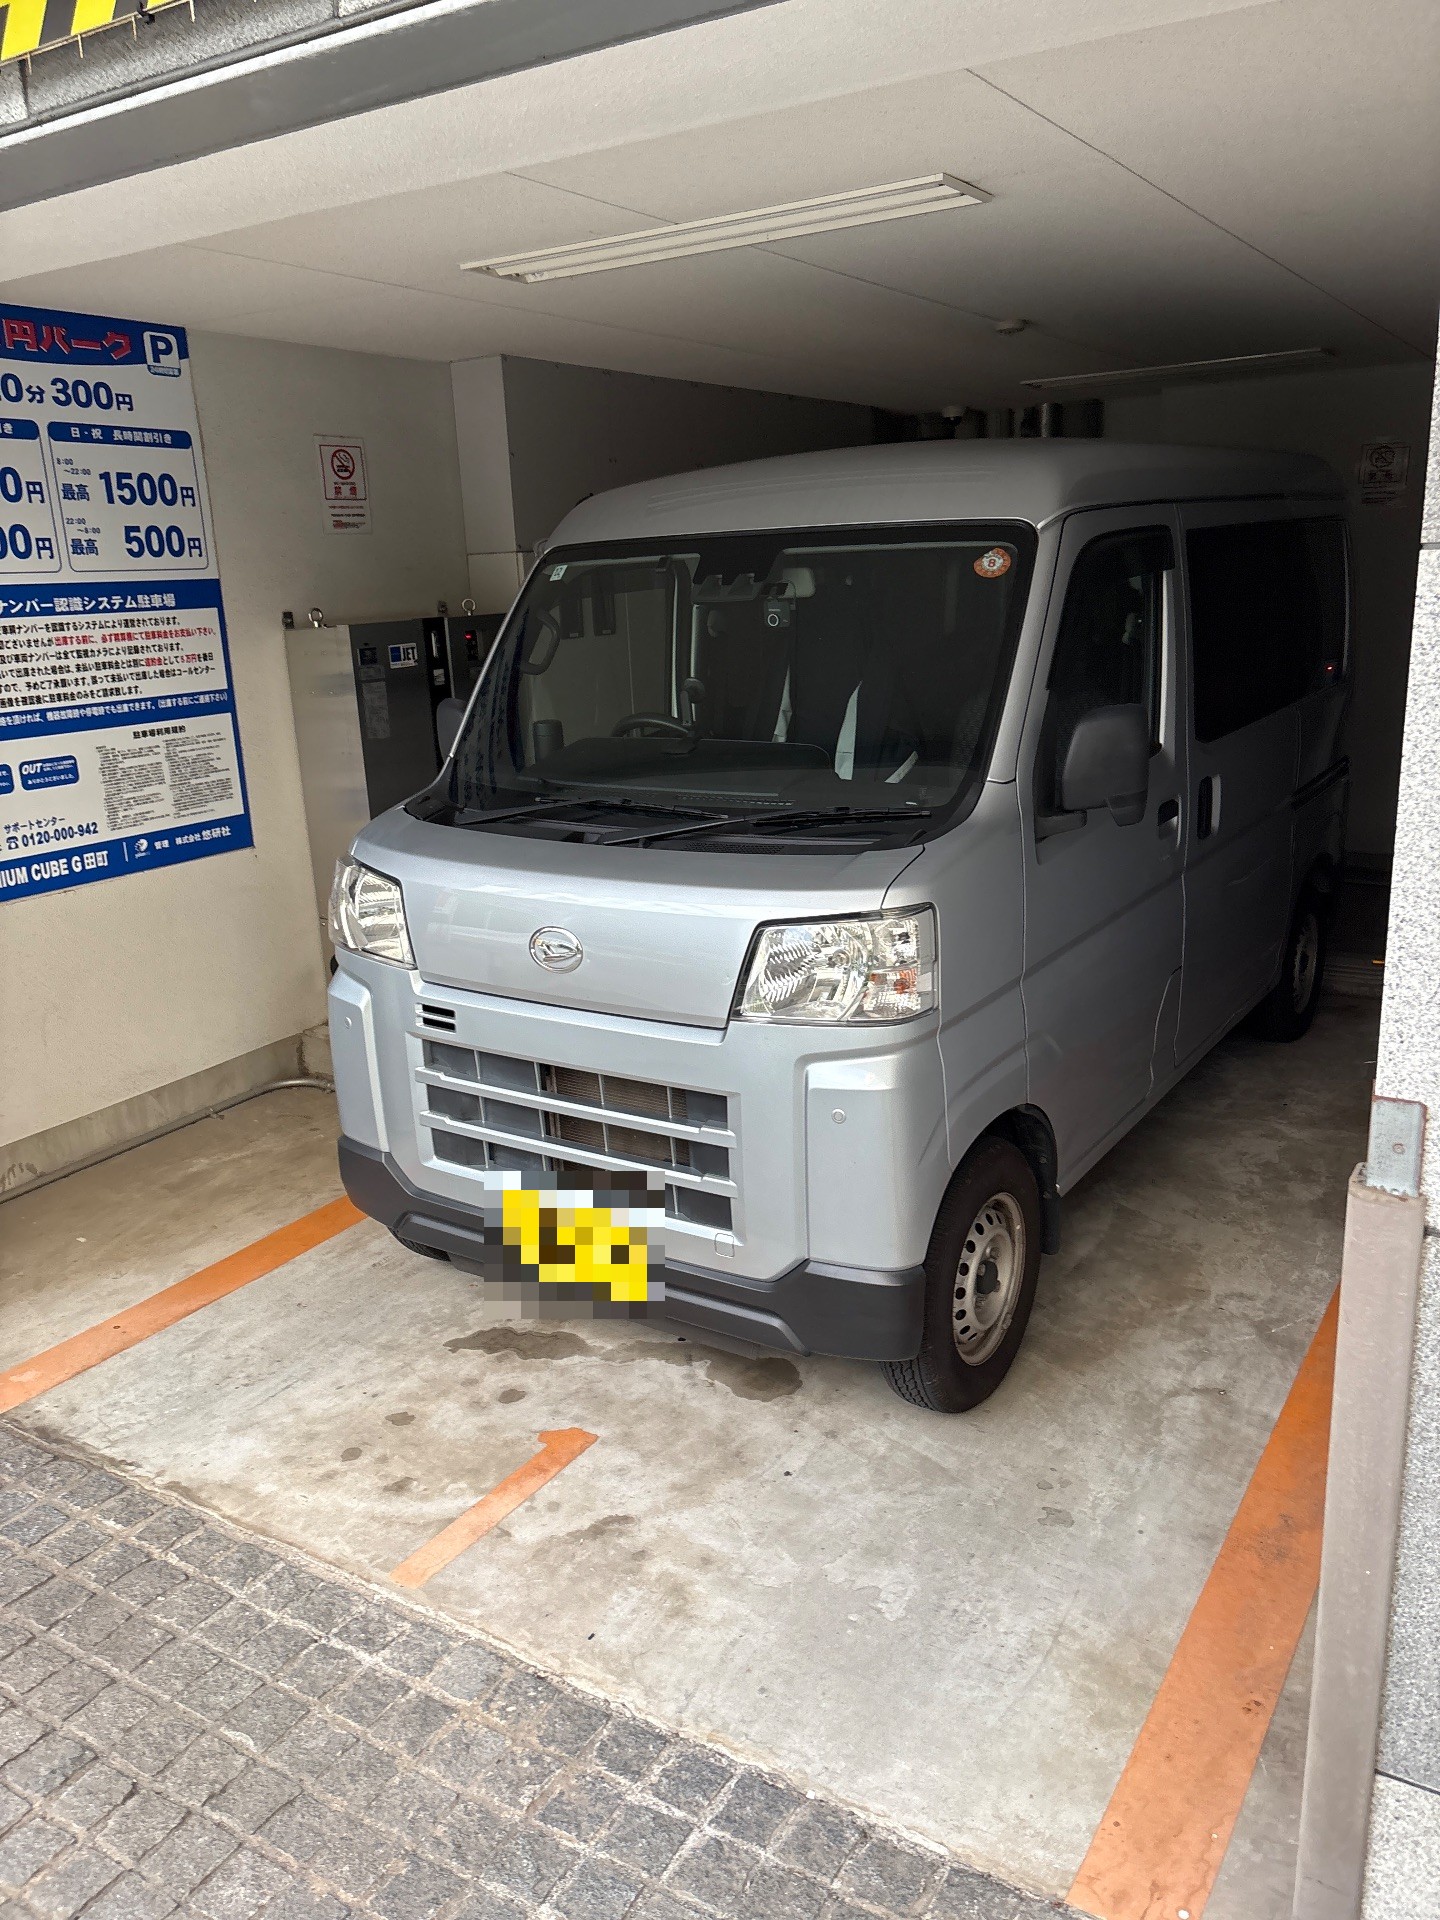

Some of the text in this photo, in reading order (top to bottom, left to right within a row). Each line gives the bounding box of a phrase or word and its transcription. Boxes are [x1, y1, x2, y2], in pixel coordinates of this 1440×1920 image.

[2, 319, 132, 360] 円パーク
[0, 373, 134, 411] 0分 300円
[61, 471, 196, 507] 最高 1500円
[70, 525, 203, 558] 最高 500円
[21, 762, 42, 775] OUT
[3, 816, 65, 834] サポートセンター
[21, 821, 98, 847] 0120-000-942
[31, 858, 69, 881] CUBE
